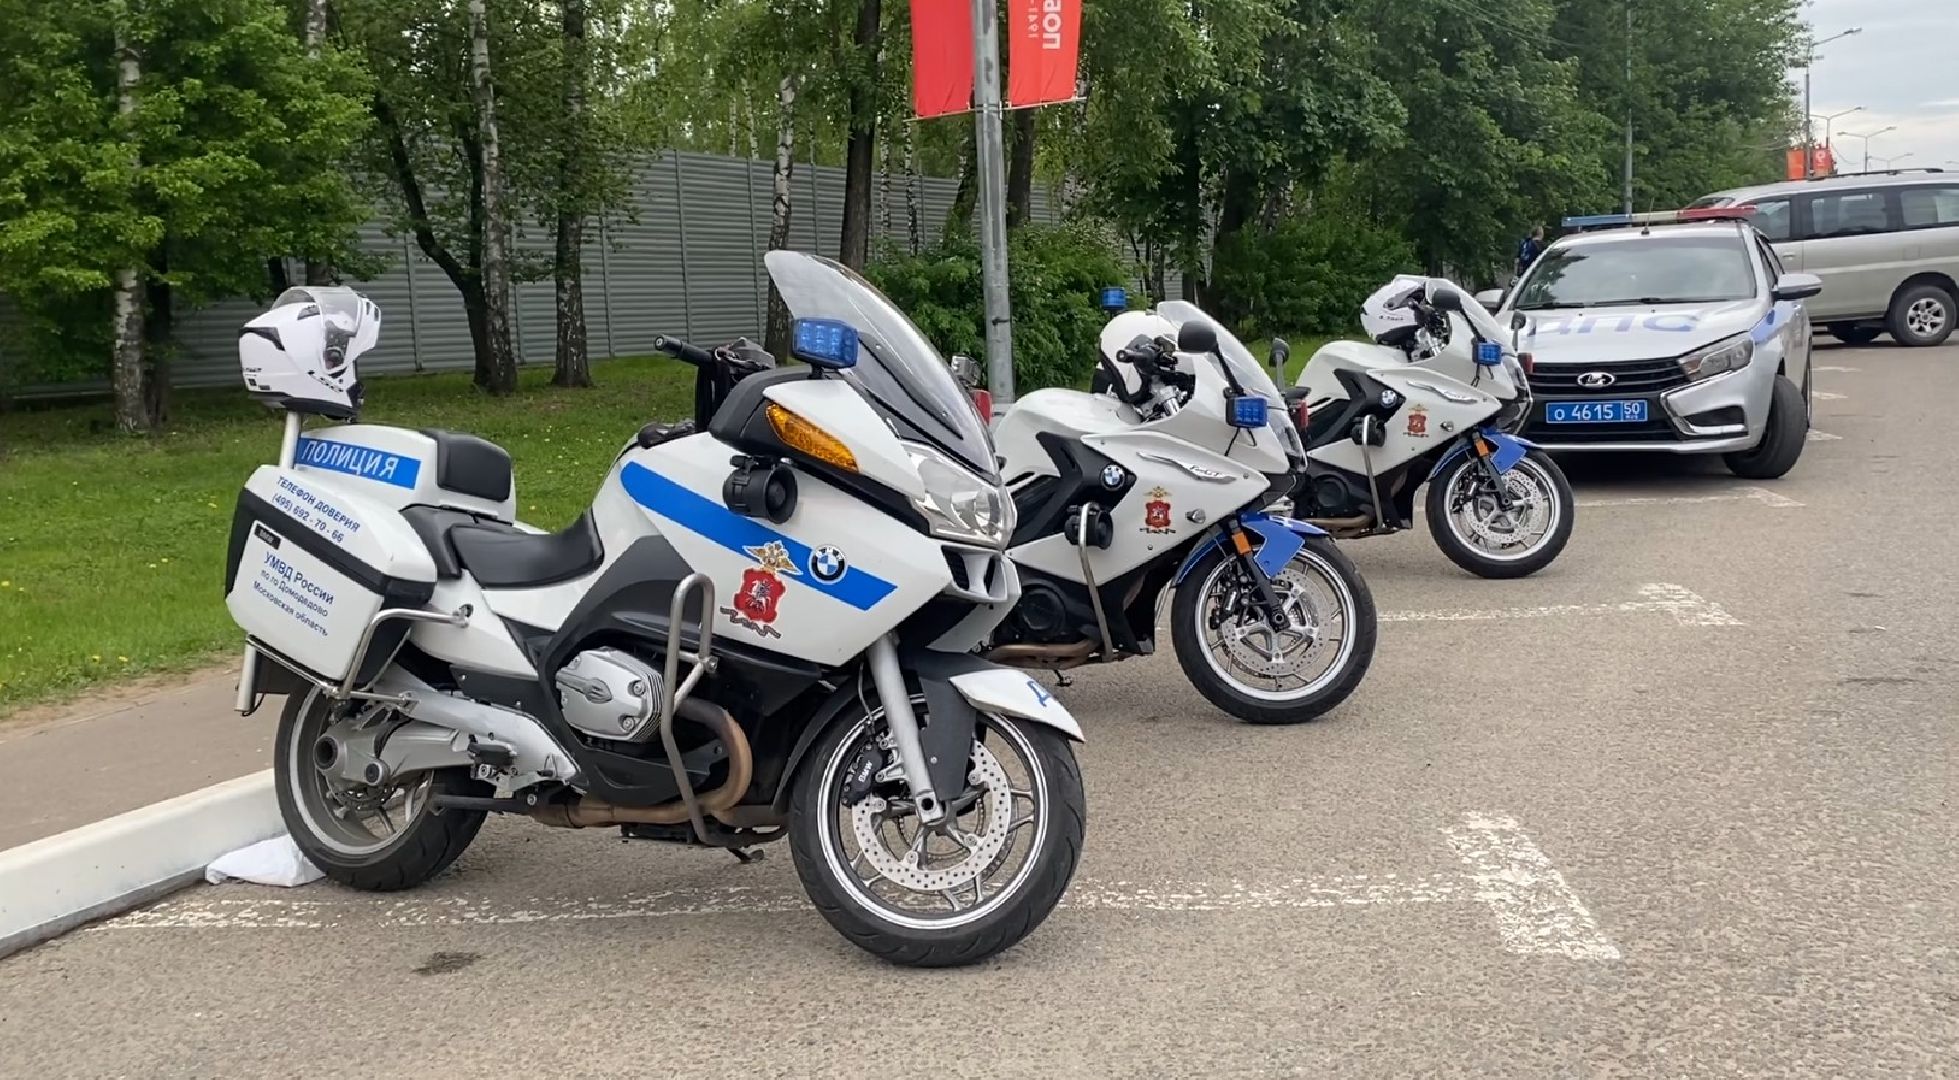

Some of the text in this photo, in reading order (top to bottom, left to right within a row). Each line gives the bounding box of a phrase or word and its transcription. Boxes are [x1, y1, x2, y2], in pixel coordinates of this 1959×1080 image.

[1571, 404, 1614, 420] 4615
[1624, 403, 1640, 415] 50
[302, 440, 399, 480] ПОЛИЦИЯ
[272, 492, 293, 510] (495)
[277, 475, 361, 533] ТЕЛЕФОН ДОВЕРИЯ
[264, 551, 334, 605] УМВД России
[254, 580, 328, 637] Московская область
[279, 580, 328, 617] Домодедово
